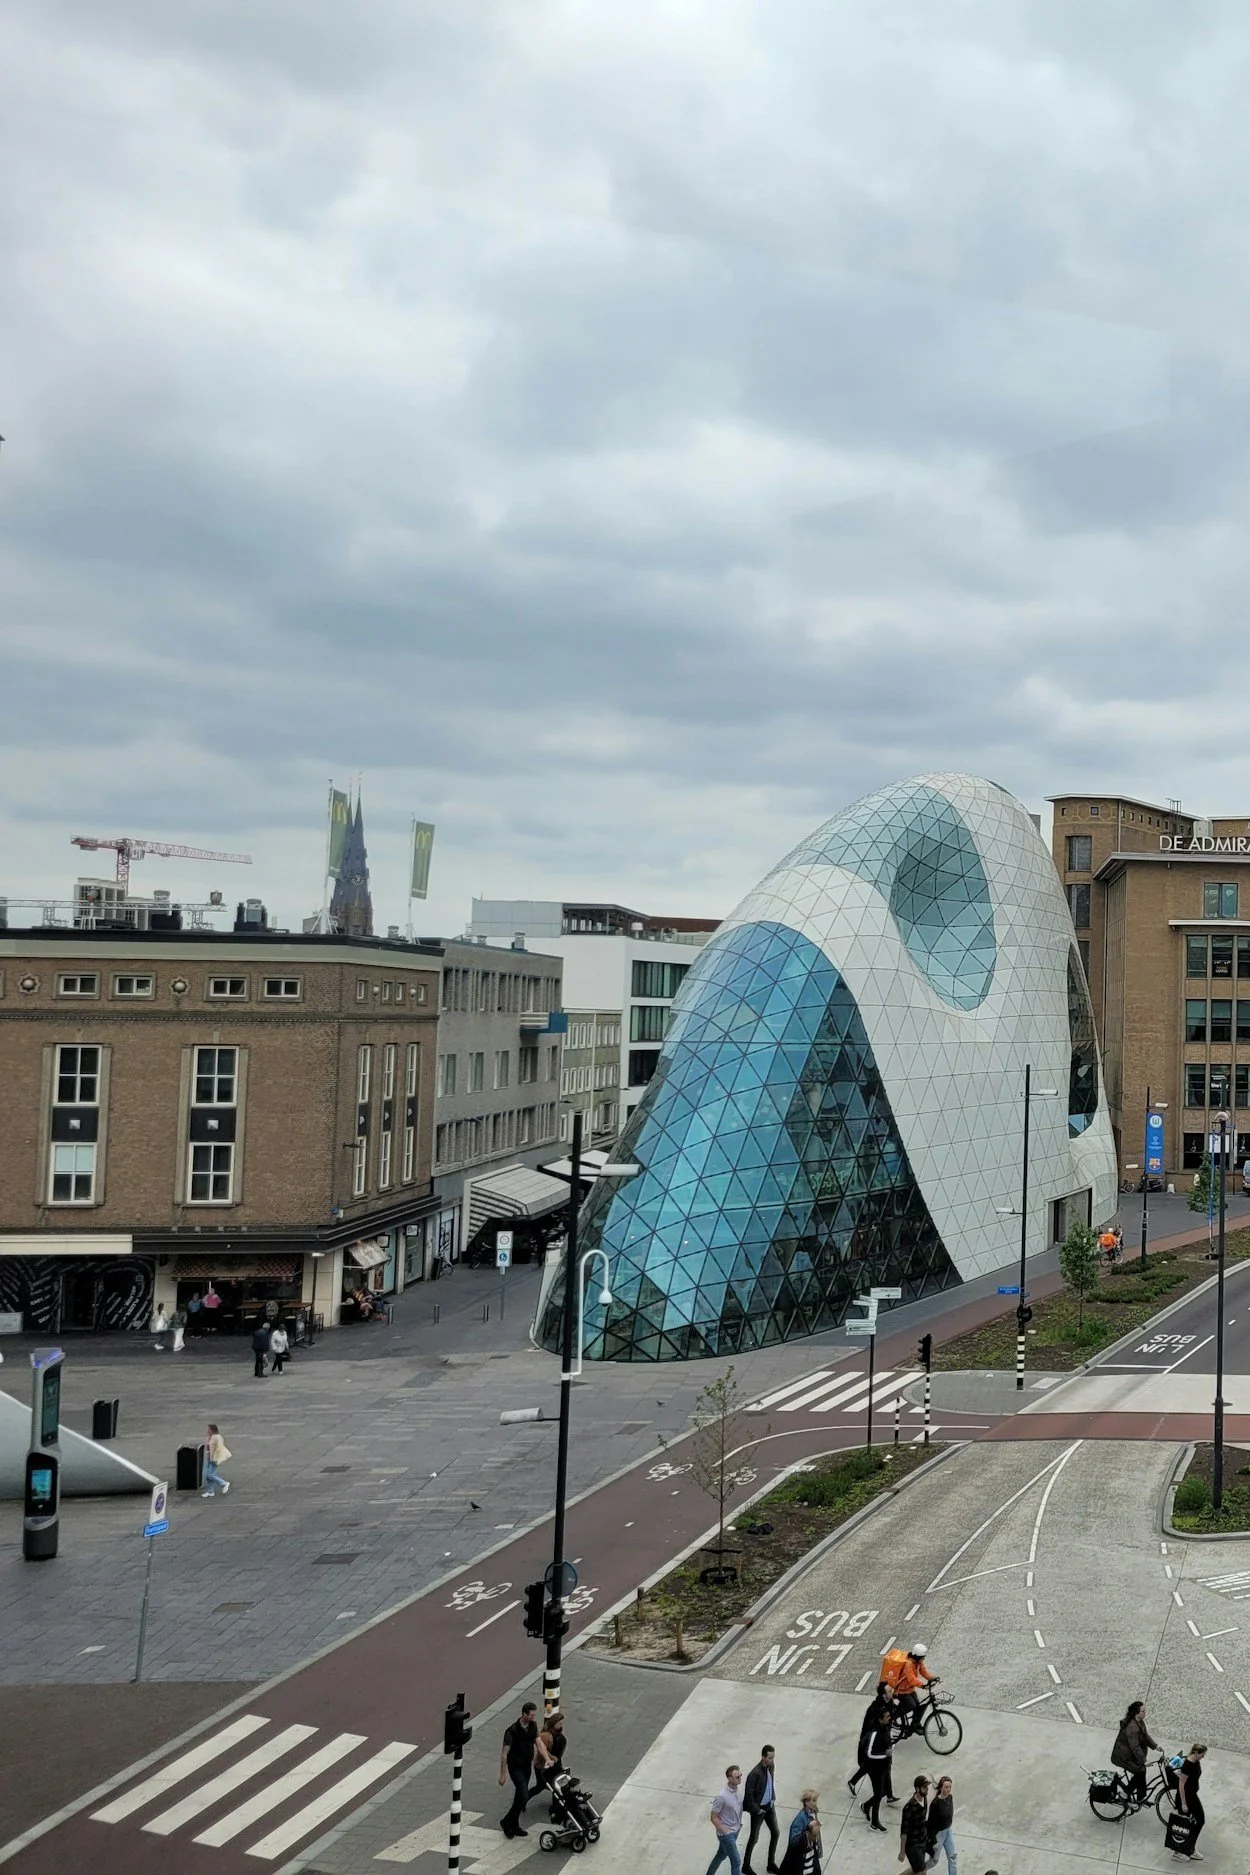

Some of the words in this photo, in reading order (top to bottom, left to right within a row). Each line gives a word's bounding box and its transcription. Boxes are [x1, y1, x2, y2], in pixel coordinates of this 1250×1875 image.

[1159, 835, 1183, 851] DE
[1149, 1334, 1198, 1344] BUS
[785, 1610, 880, 1638] BUS
